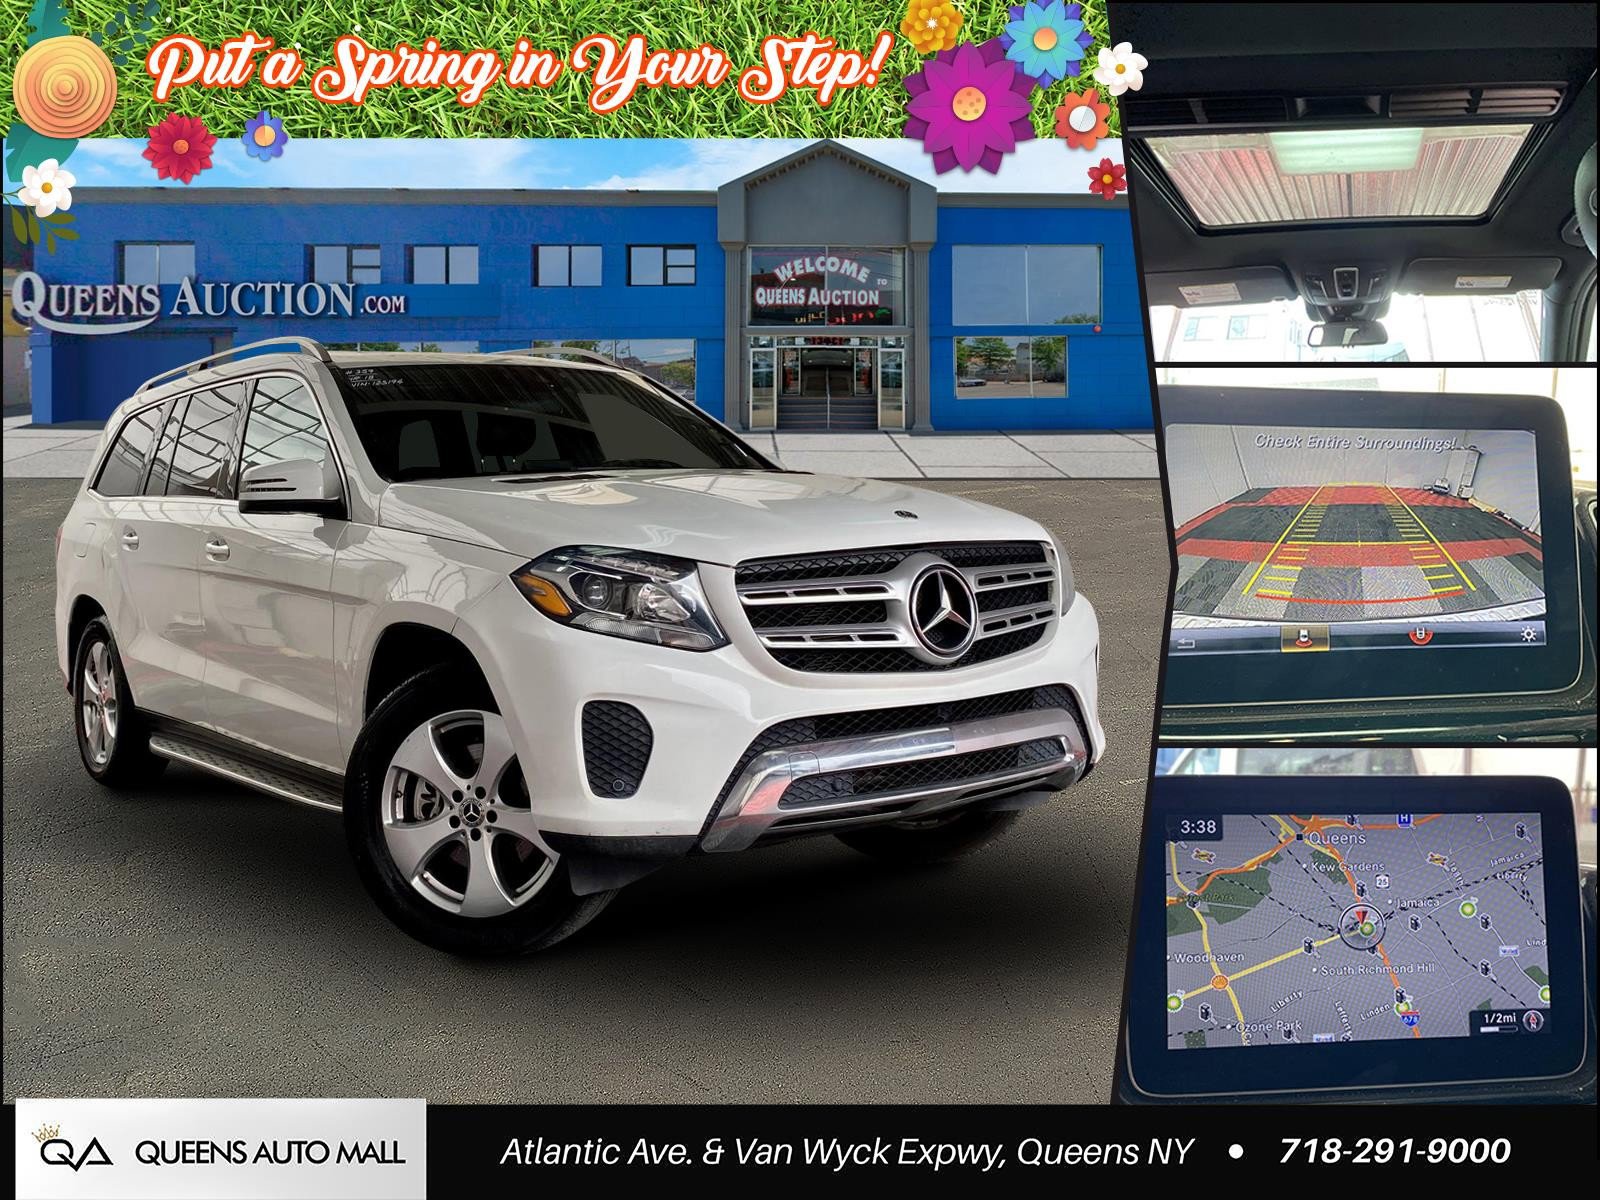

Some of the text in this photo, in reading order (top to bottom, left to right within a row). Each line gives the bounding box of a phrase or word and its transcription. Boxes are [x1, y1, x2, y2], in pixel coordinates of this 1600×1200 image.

[773, 255, 888, 286] WELCOME TO
[11, 270, 161, 335] QUEENS
[755, 286, 880, 306] QUEENS AUCTION
[1254, 433, 1457, 453] Check Entire Surroundings!
[1180, 820, 1217, 834] 3:38
[1309, 831, 1367, 845] Queens
[1311, 862, 1385, 872] Kew Gardens
[1490, 852, 1525, 868] Jamaica
[1496, 872, 1528, 882] Liberty
[1396, 898, 1440, 909] Jamaica
[1174, 952, 1245, 964] Woodhaven
[1321, 962, 1435, 976] South Richmond Hill
[1270, 989, 1304, 1013] Liberty
[1360, 1003, 1391, 1020] Linden
[1484, 1012, 1516, 1023] 1/2mi
[1235, 1020, 1302, 1033] Ozone Park
[1403, 1016, 1418, 1024] 678
